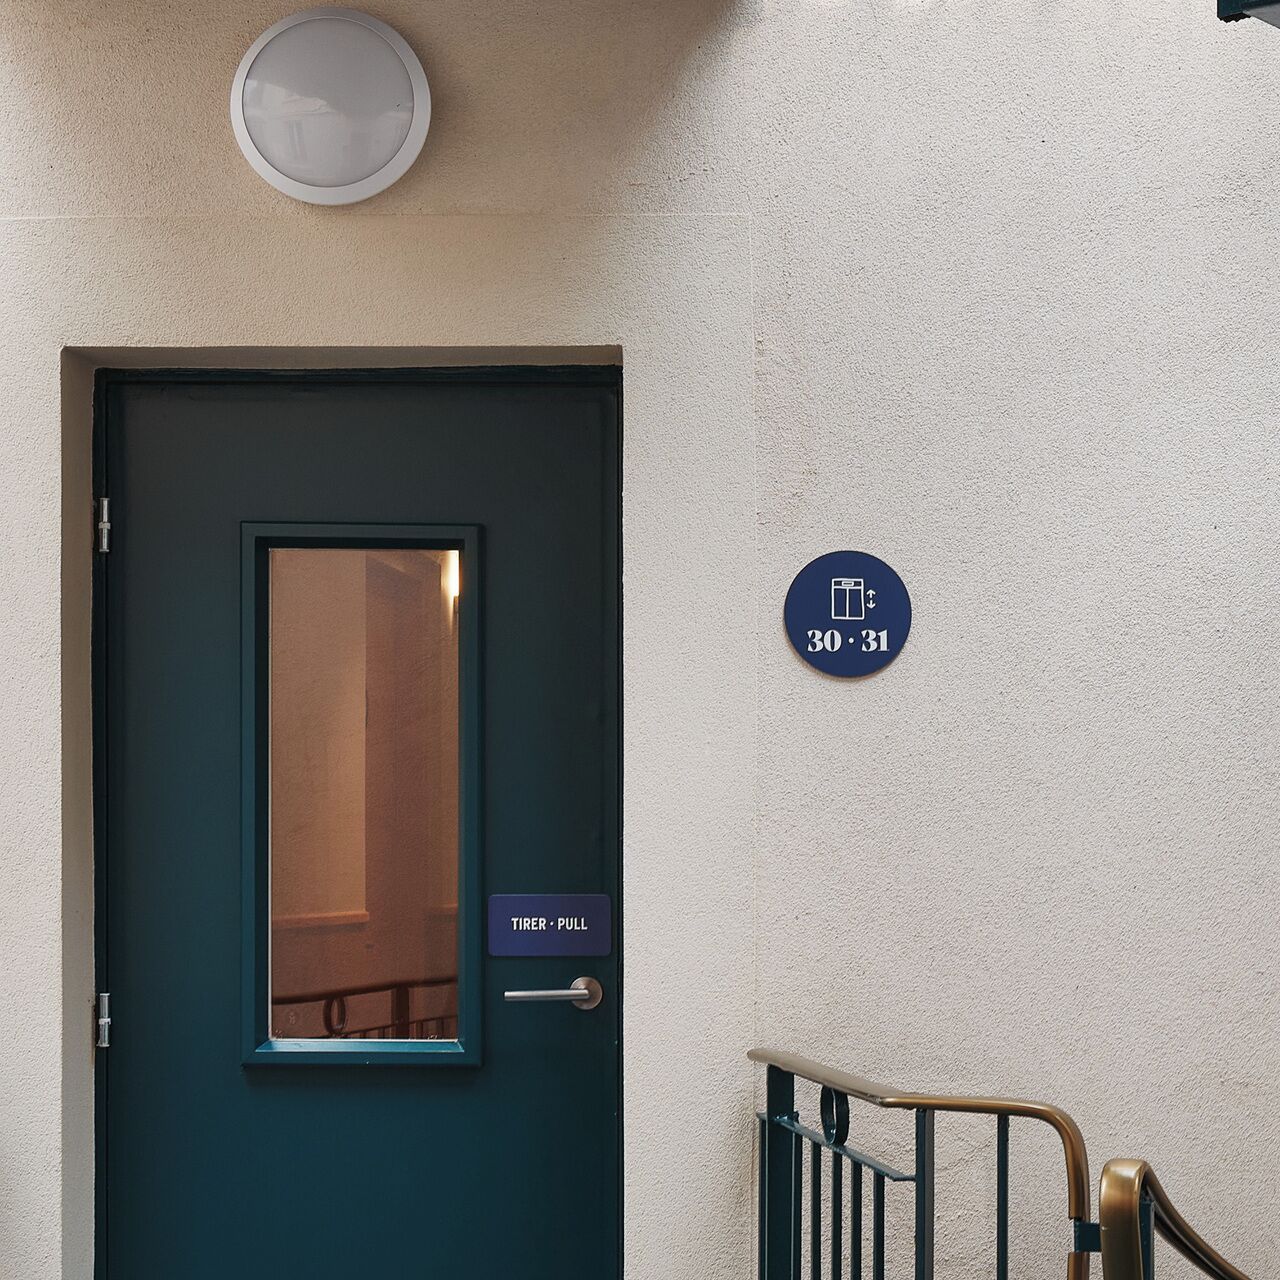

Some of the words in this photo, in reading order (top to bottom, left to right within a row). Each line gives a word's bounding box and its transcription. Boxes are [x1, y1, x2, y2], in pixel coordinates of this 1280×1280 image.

[807, 629, 842, 652] 30
[861, 629, 889, 652] 31
[511, 917, 547, 930] TIRER
[558, 917, 588, 930] PULL
